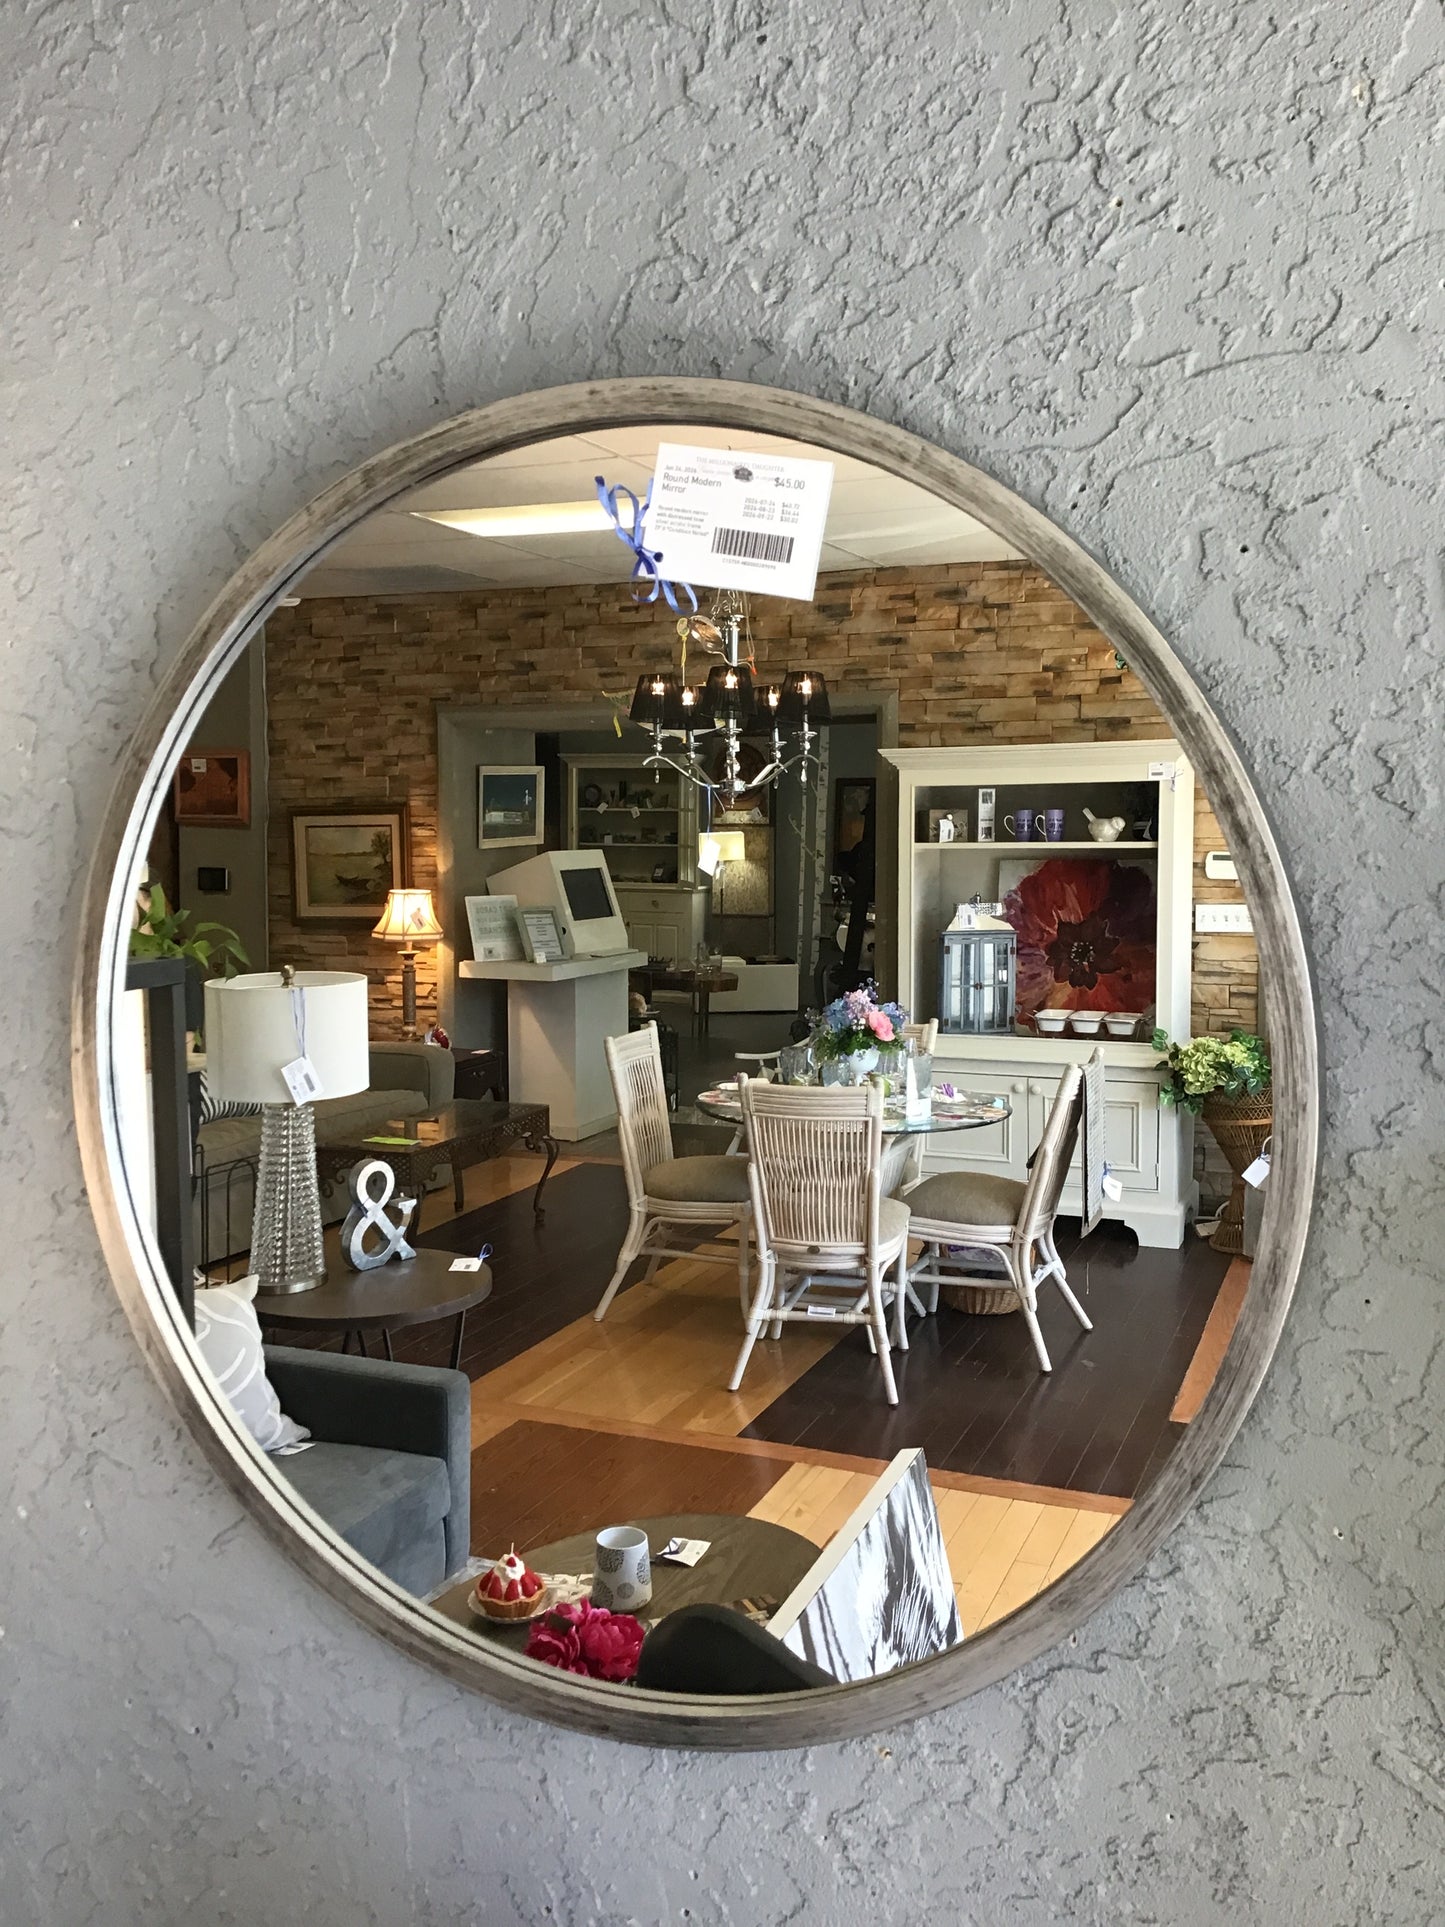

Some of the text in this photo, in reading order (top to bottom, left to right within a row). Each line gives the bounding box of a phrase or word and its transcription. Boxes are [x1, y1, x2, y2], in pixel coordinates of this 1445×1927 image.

[663, 472, 690, 484] Round
[691, 476, 722, 488] Modern
[774, 477, 805, 490] $45.00
[662, 483, 687, 494] Mirror
